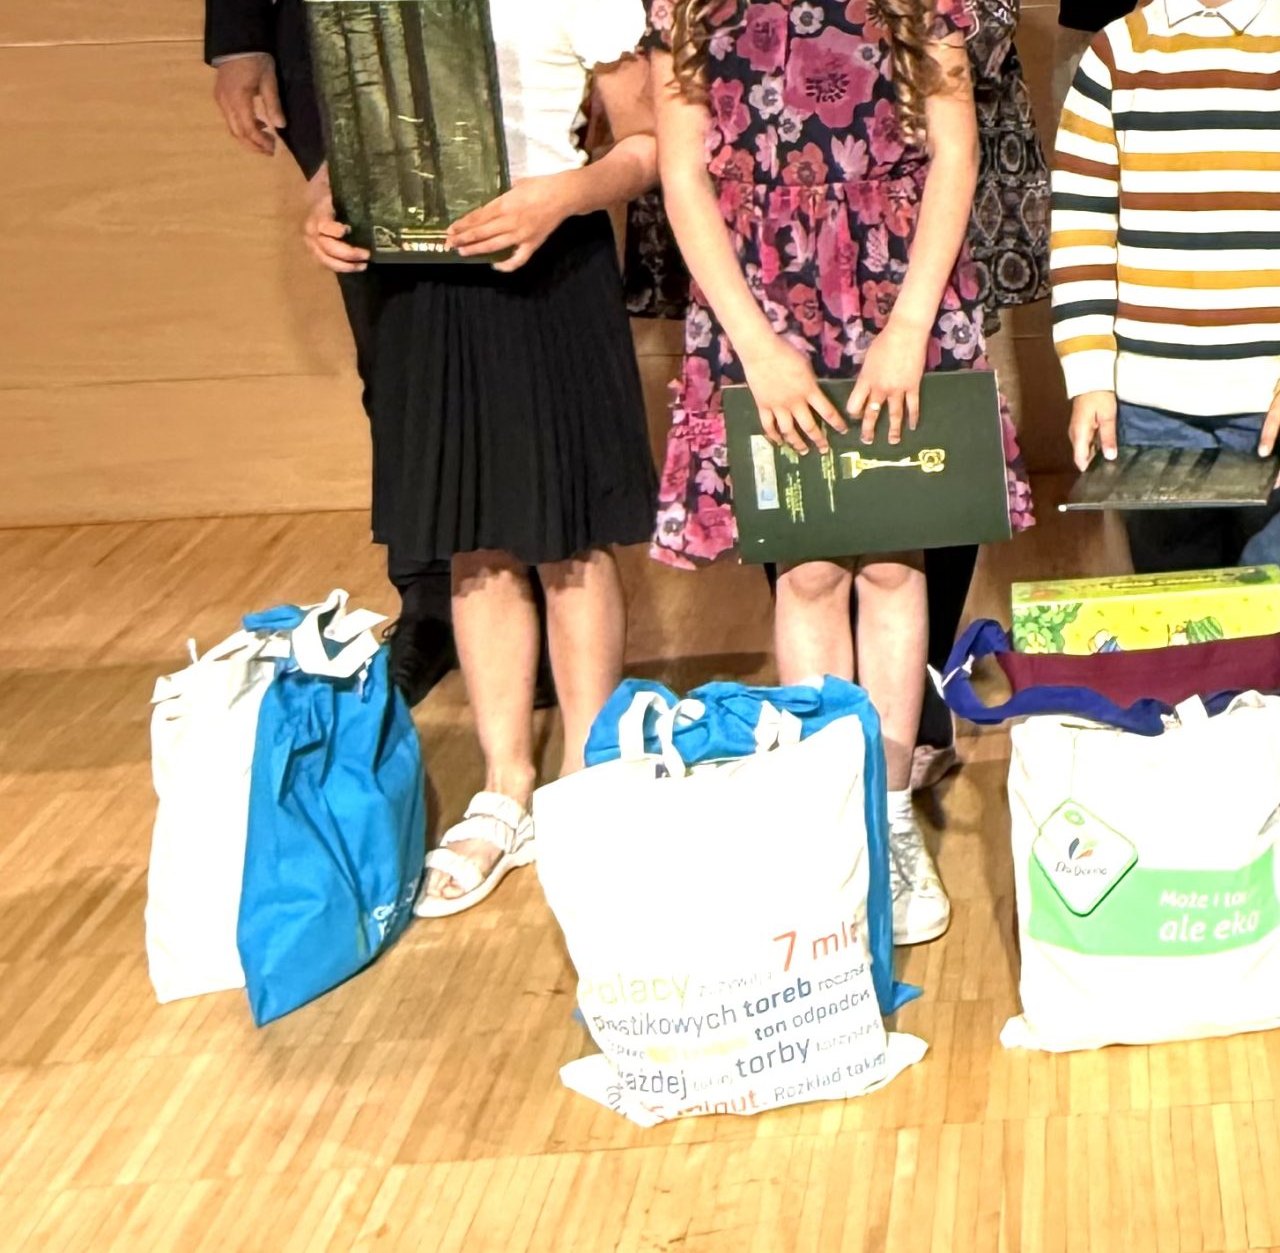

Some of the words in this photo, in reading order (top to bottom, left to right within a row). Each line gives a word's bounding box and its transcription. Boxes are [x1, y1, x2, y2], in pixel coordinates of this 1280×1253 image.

[1158, 912, 1206, 942] ale
[1213, 908, 1260, 941] eko
[773, 931, 796, 973] 7
[743, 977, 812, 1019] toreb
[753, 1018, 788, 1042] ton
[735, 1036, 810, 1079] torby
